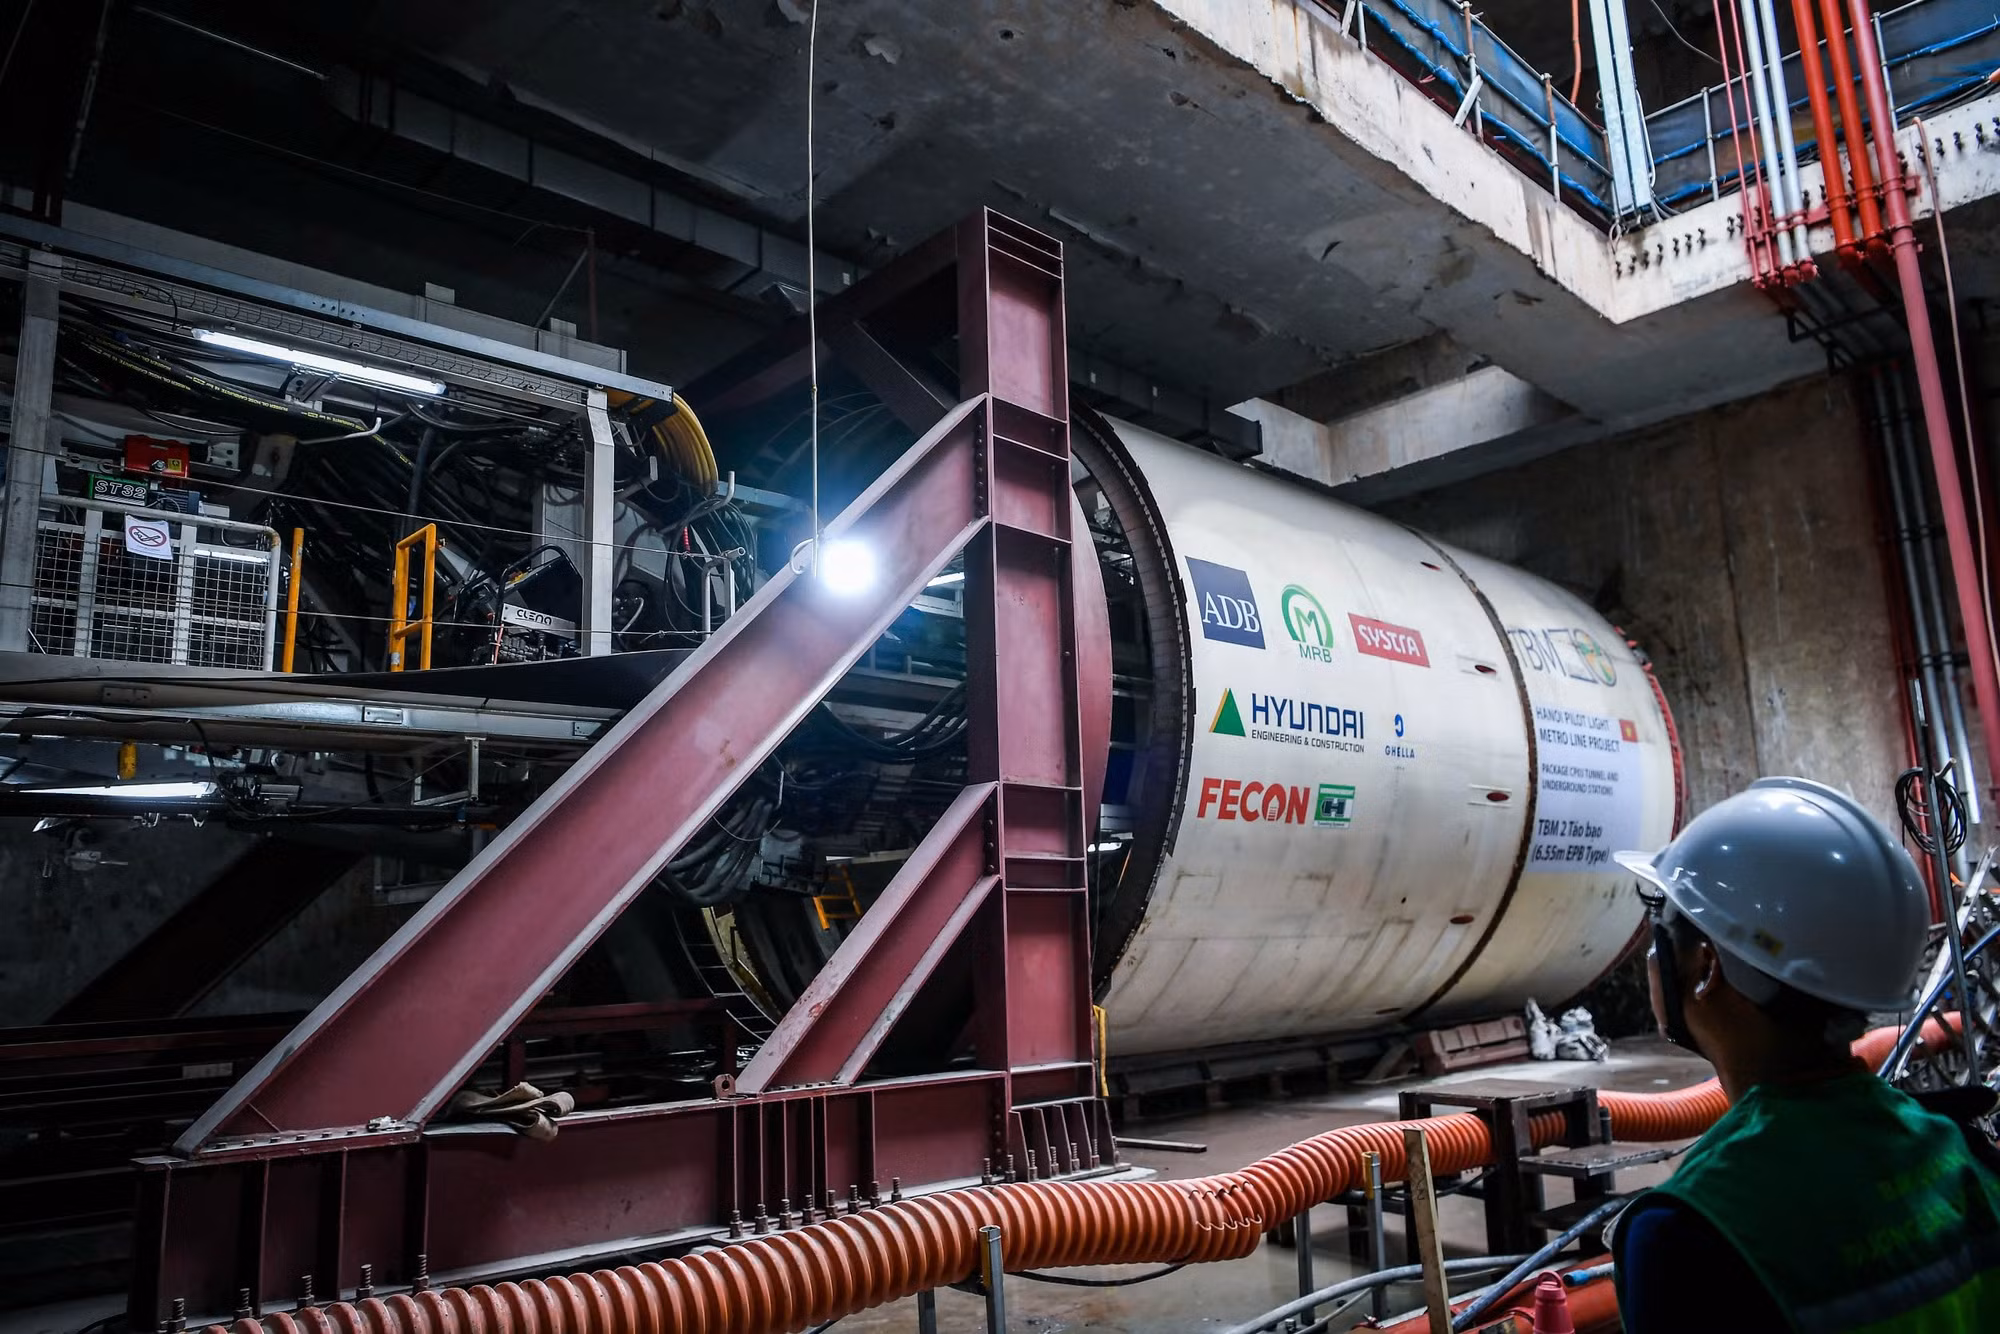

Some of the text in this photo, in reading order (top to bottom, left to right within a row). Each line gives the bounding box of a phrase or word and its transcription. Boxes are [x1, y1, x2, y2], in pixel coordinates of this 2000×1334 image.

[95, 480, 146, 499] ST32
[1203, 592, 1260, 633] ADB
[1358, 624, 1420, 657] SYSTRA
[1299, 644, 1332, 663] MRB
[1252, 693, 1364, 739] HYUNDAI
[1535, 706, 1609, 731] HANOI PILOT LIGHT
[1251, 729, 1365, 753] ENGINEERING & CONSTRUCTION
[1539, 728, 1620, 753] METRO LINE PROJECT
[1385, 745, 1415, 759] GHELLA
[1541, 762, 1569, 777] PACKAGE
[1607, 771, 1618, 781] AND
[1541, 779, 1587, 794] UNDERGROUND
[1197, 777, 1310, 825] FECON
[1538, 819, 1559, 836] TBM
[1560, 820, 1567, 837] 2
[1532, 844, 1610, 865] (6.55m EPB Type)
